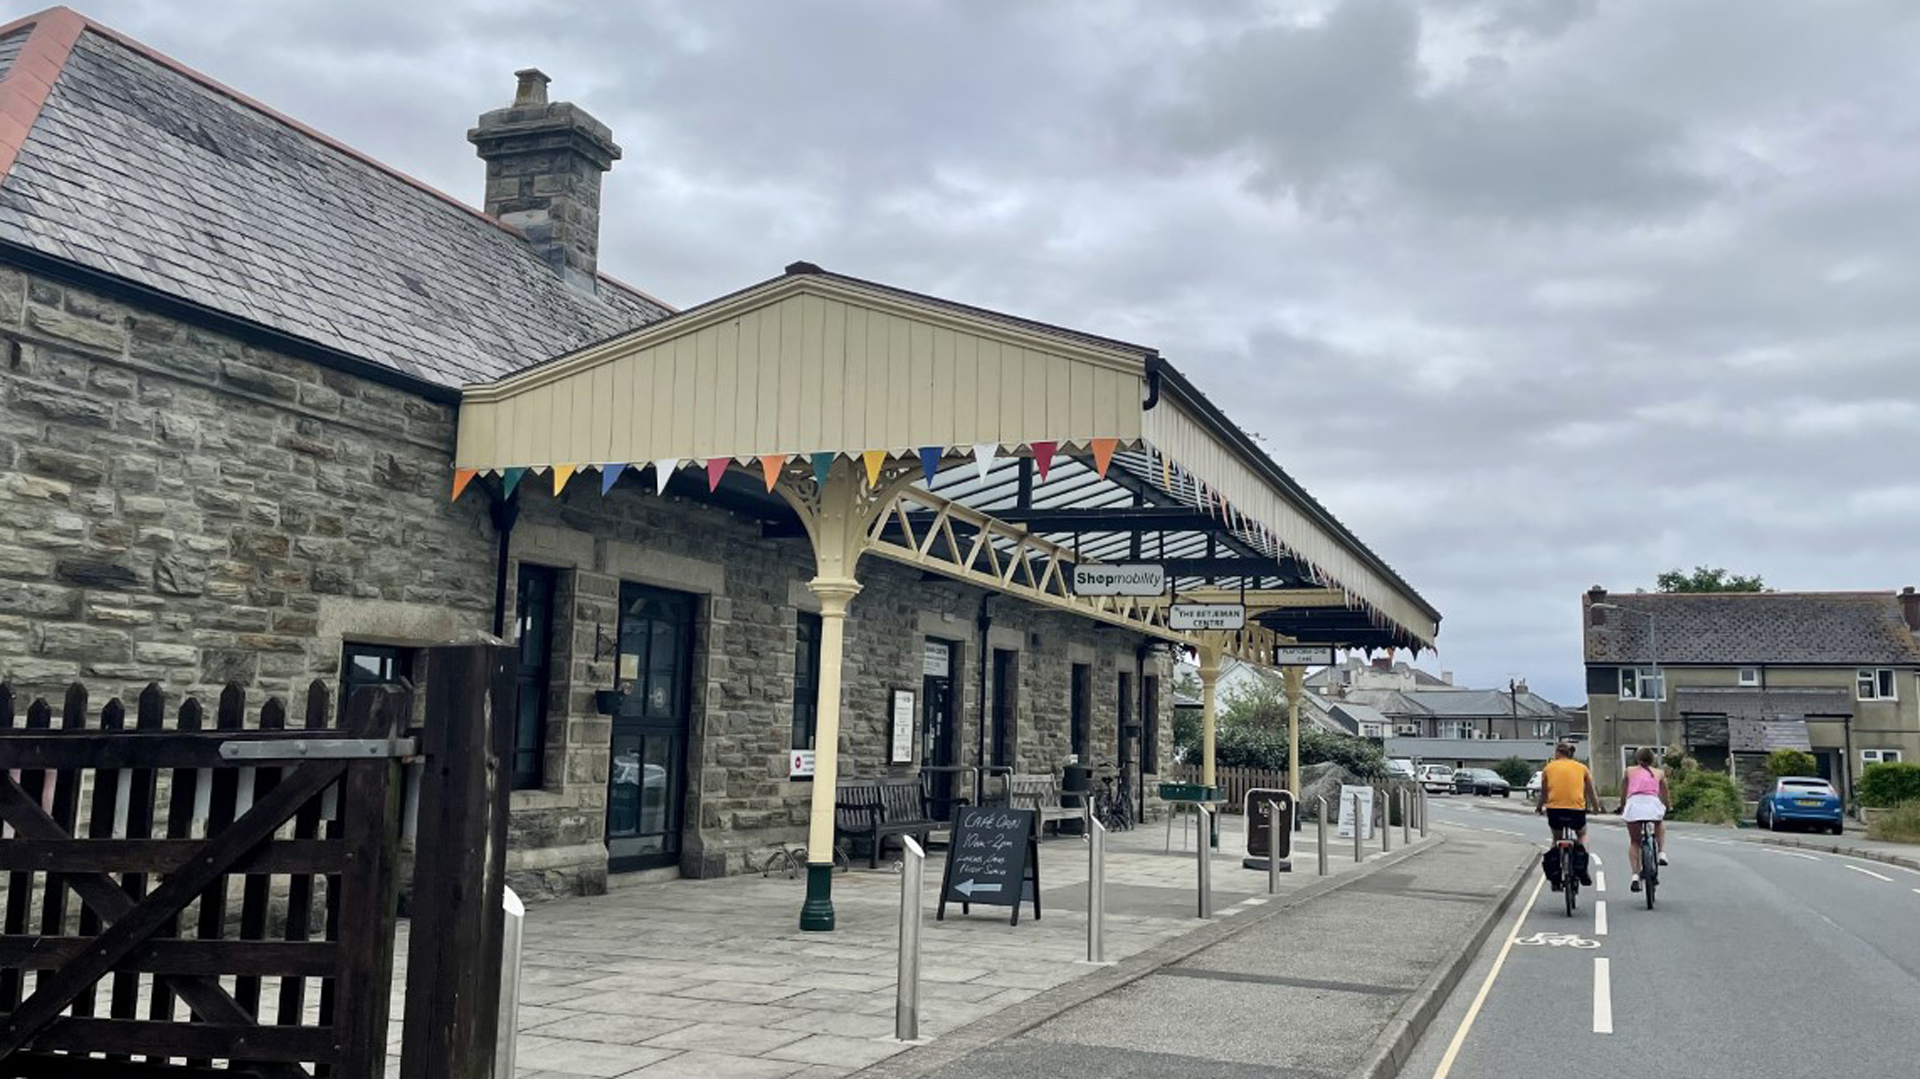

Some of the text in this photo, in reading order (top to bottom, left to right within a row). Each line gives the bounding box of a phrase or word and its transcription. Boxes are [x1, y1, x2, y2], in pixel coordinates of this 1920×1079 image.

[1077, 572, 1161, 587] Shopmobility
[1179, 610, 1240, 618] THE BETJEMAN
[1193, 619, 1225, 627] CENTRE
